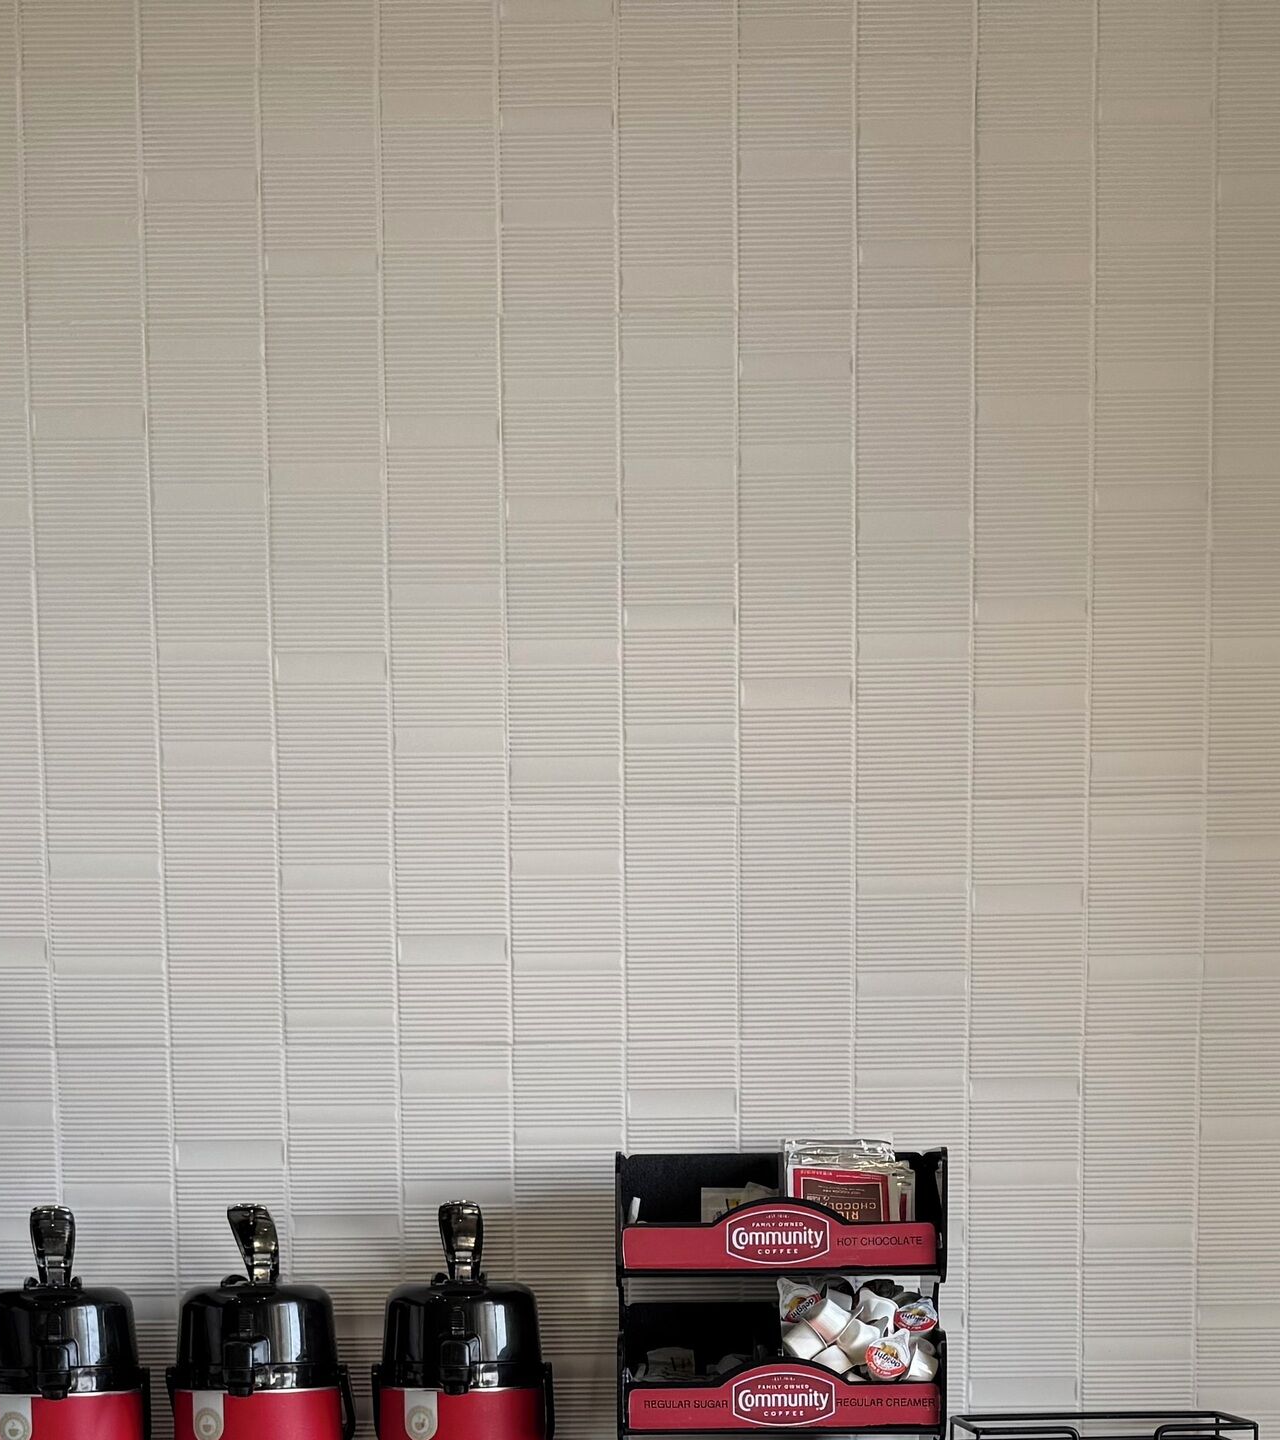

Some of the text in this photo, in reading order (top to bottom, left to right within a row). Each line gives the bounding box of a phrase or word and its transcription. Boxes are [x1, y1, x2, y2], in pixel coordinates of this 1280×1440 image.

[731, 1226, 824, 1250] Community
[836, 1235, 923, 1246] HOT CHOCOLATE
[643, 1399, 728, 1409] REGULAR SUGAR
[738, 1388, 829, 1411] Community
[836, 1397, 935, 1407] REGULAR CREAMER
